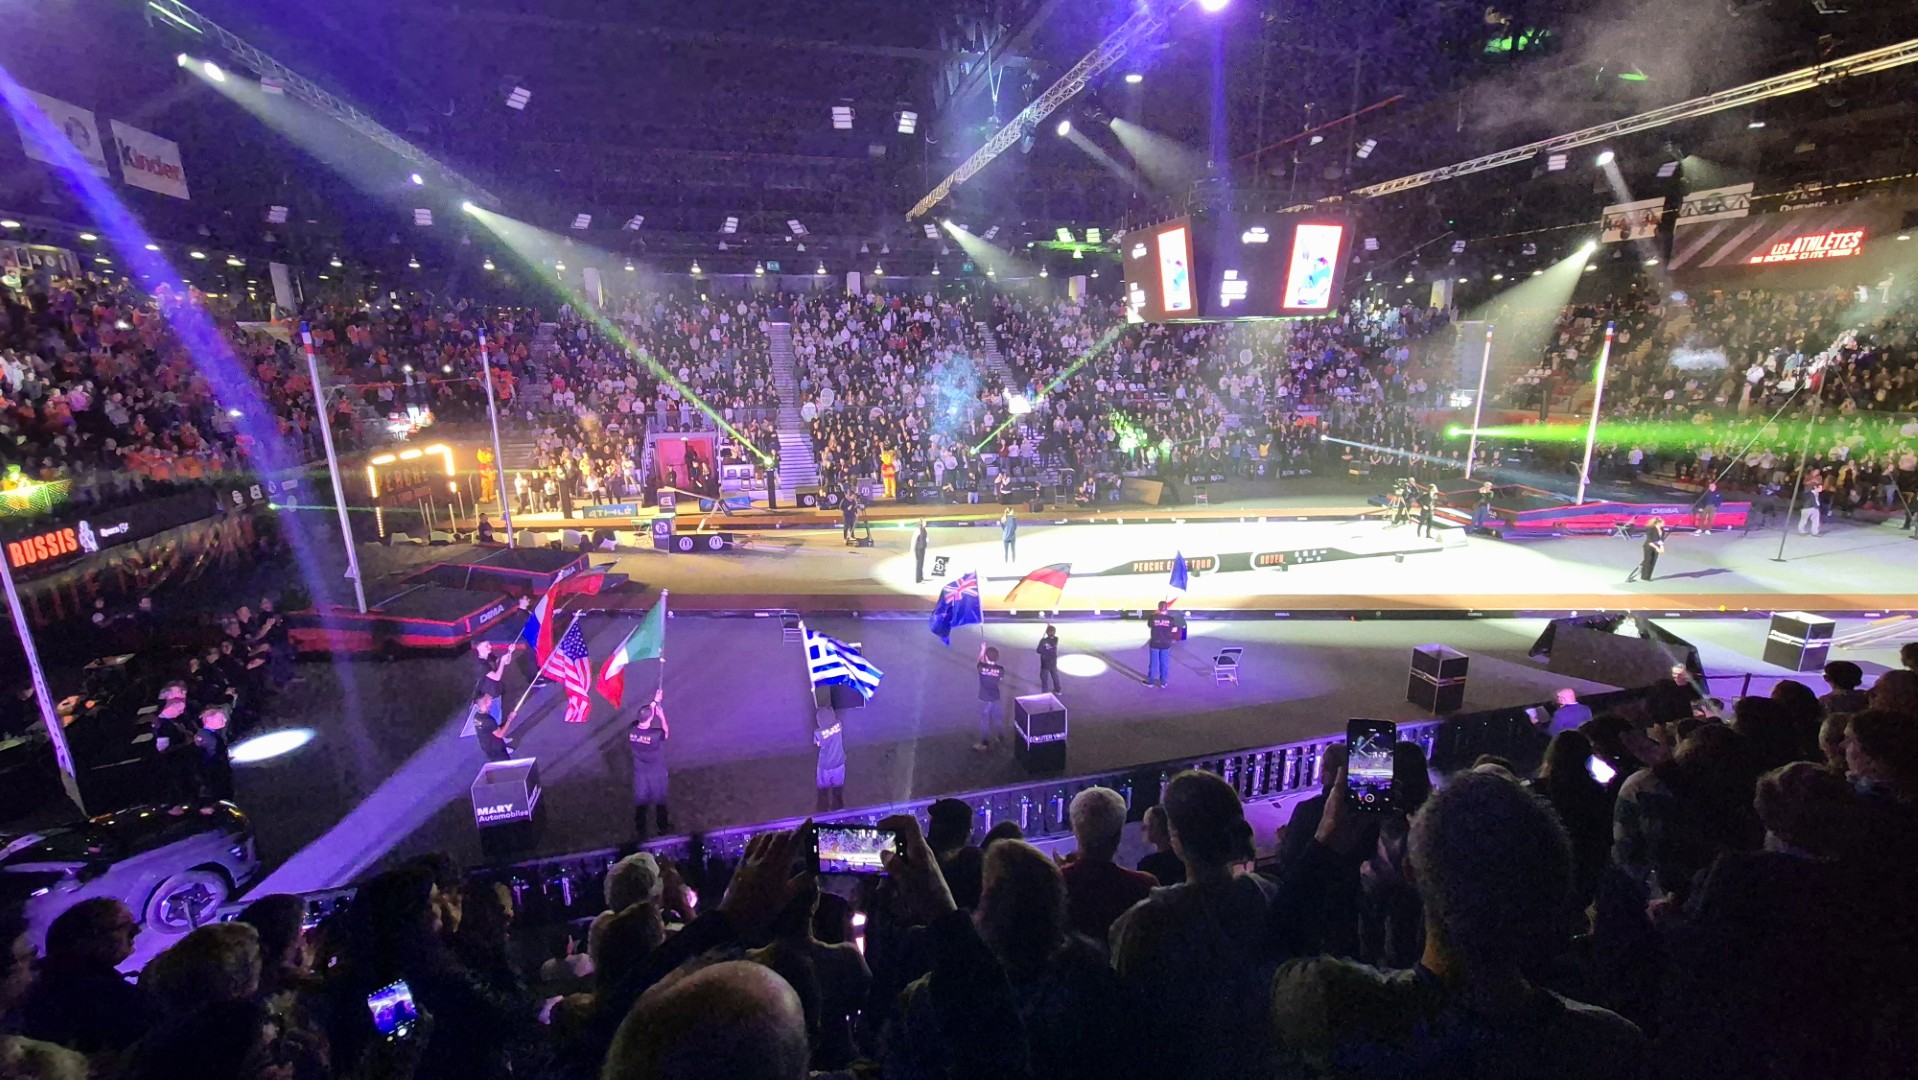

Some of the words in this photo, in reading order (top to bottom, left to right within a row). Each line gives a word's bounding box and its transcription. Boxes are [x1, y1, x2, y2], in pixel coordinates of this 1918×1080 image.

[1771, 243, 1791, 256] LES
[1788, 231, 1864, 254] ATHLÈTES
[8, 527, 78, 568] RUSSIS
[480, 604, 505, 624] DIMA
[477, 804, 513, 816] MARY
[478, 810, 530, 822] Automobiles
